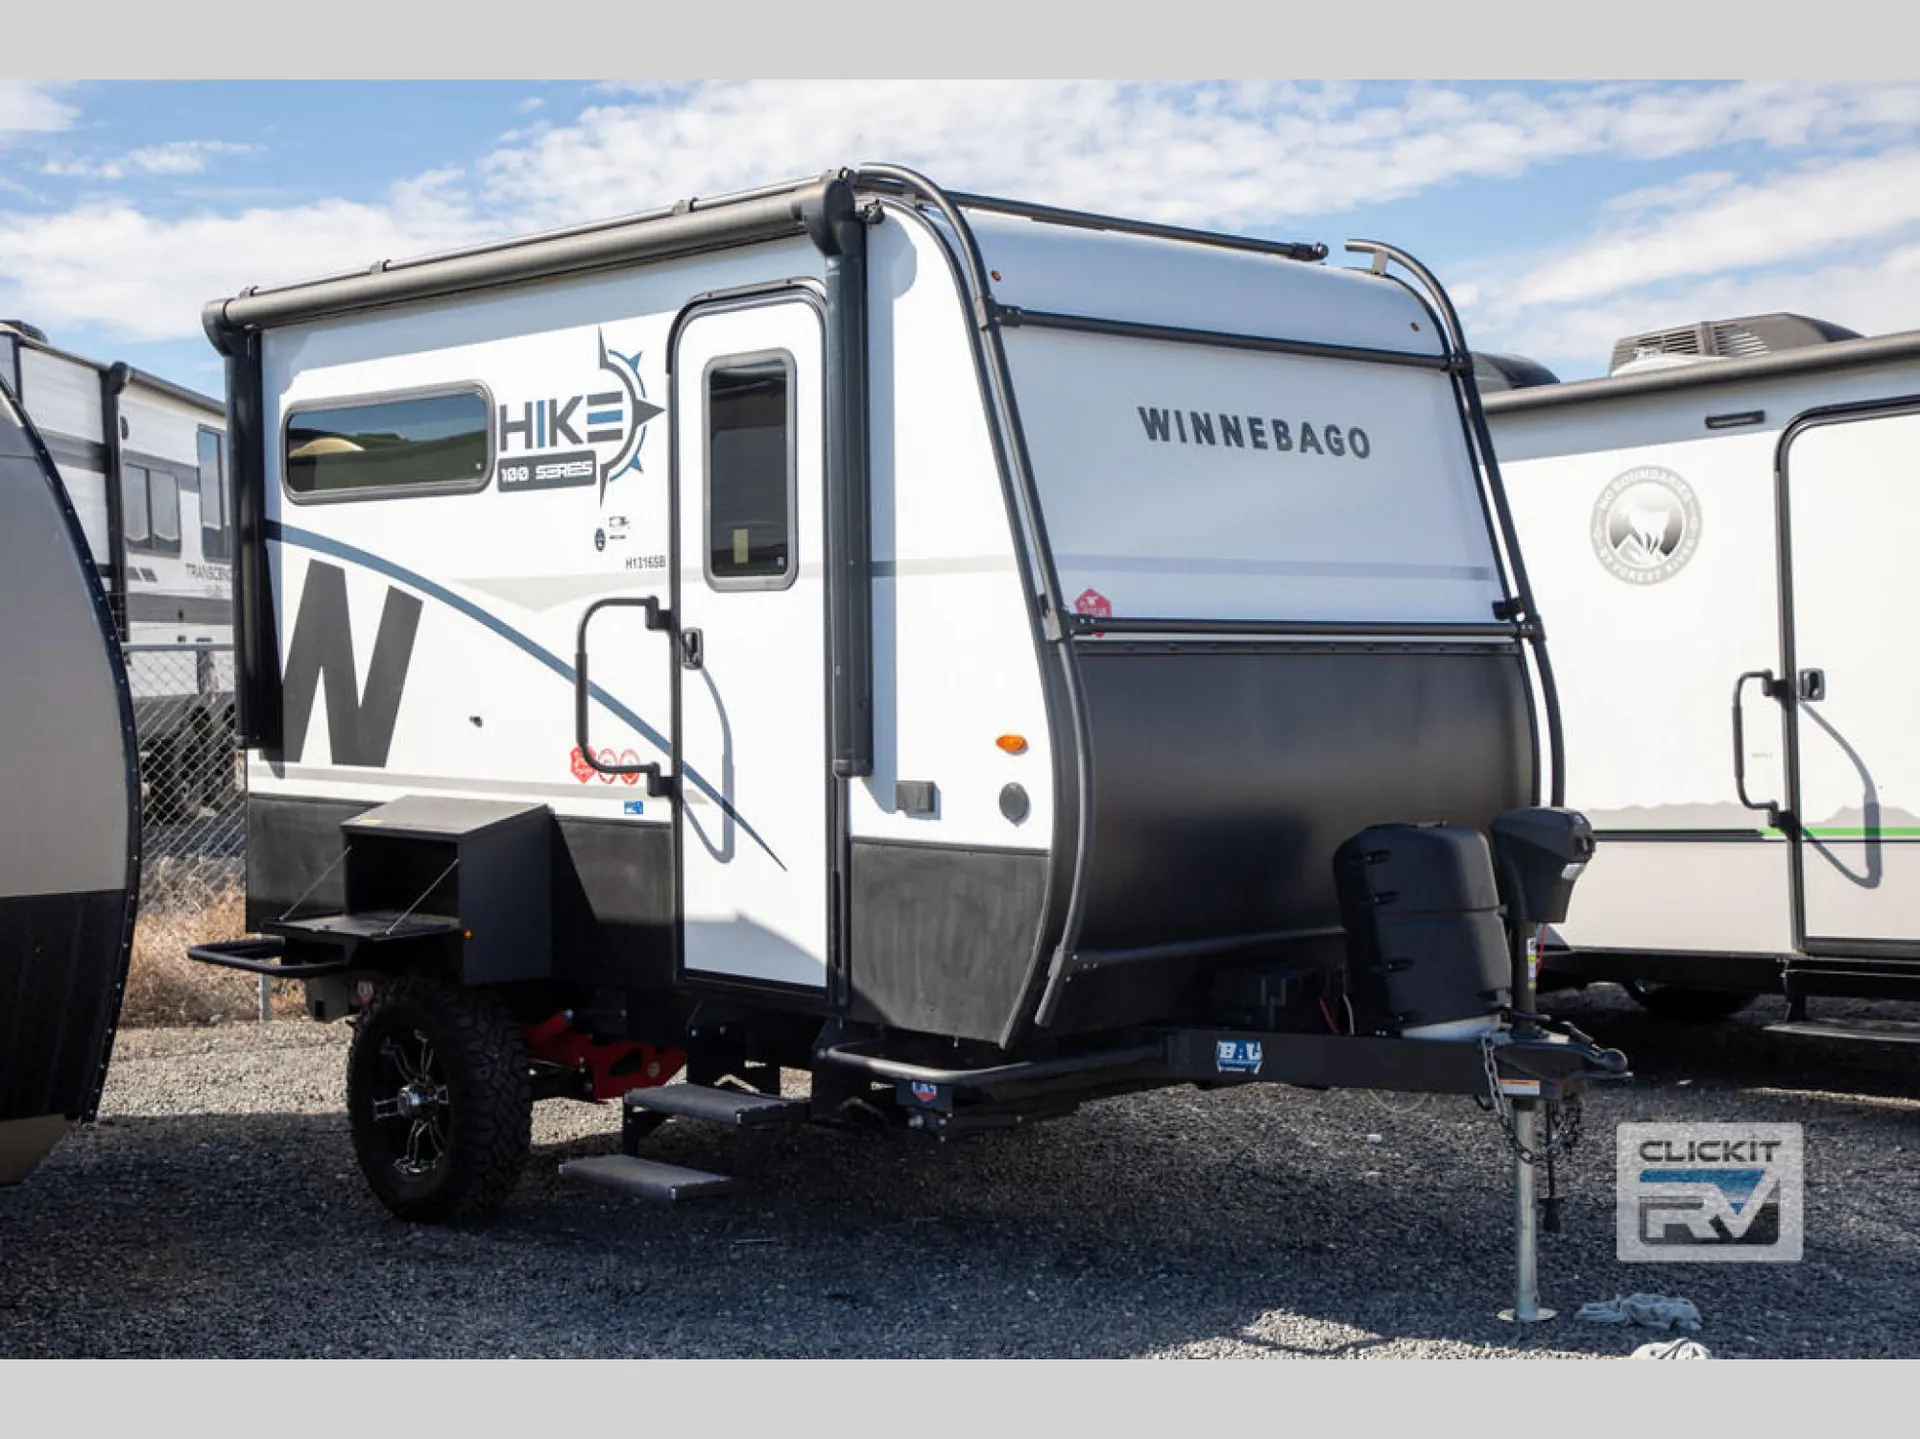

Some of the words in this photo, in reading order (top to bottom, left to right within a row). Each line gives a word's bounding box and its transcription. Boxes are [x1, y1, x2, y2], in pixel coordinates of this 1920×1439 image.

[500, 391, 623, 451] HIKE
[1137, 406, 1370, 459] WINNEBAGO
[501, 465, 529, 484] 100
[535, 460, 594, 481] SERIES
